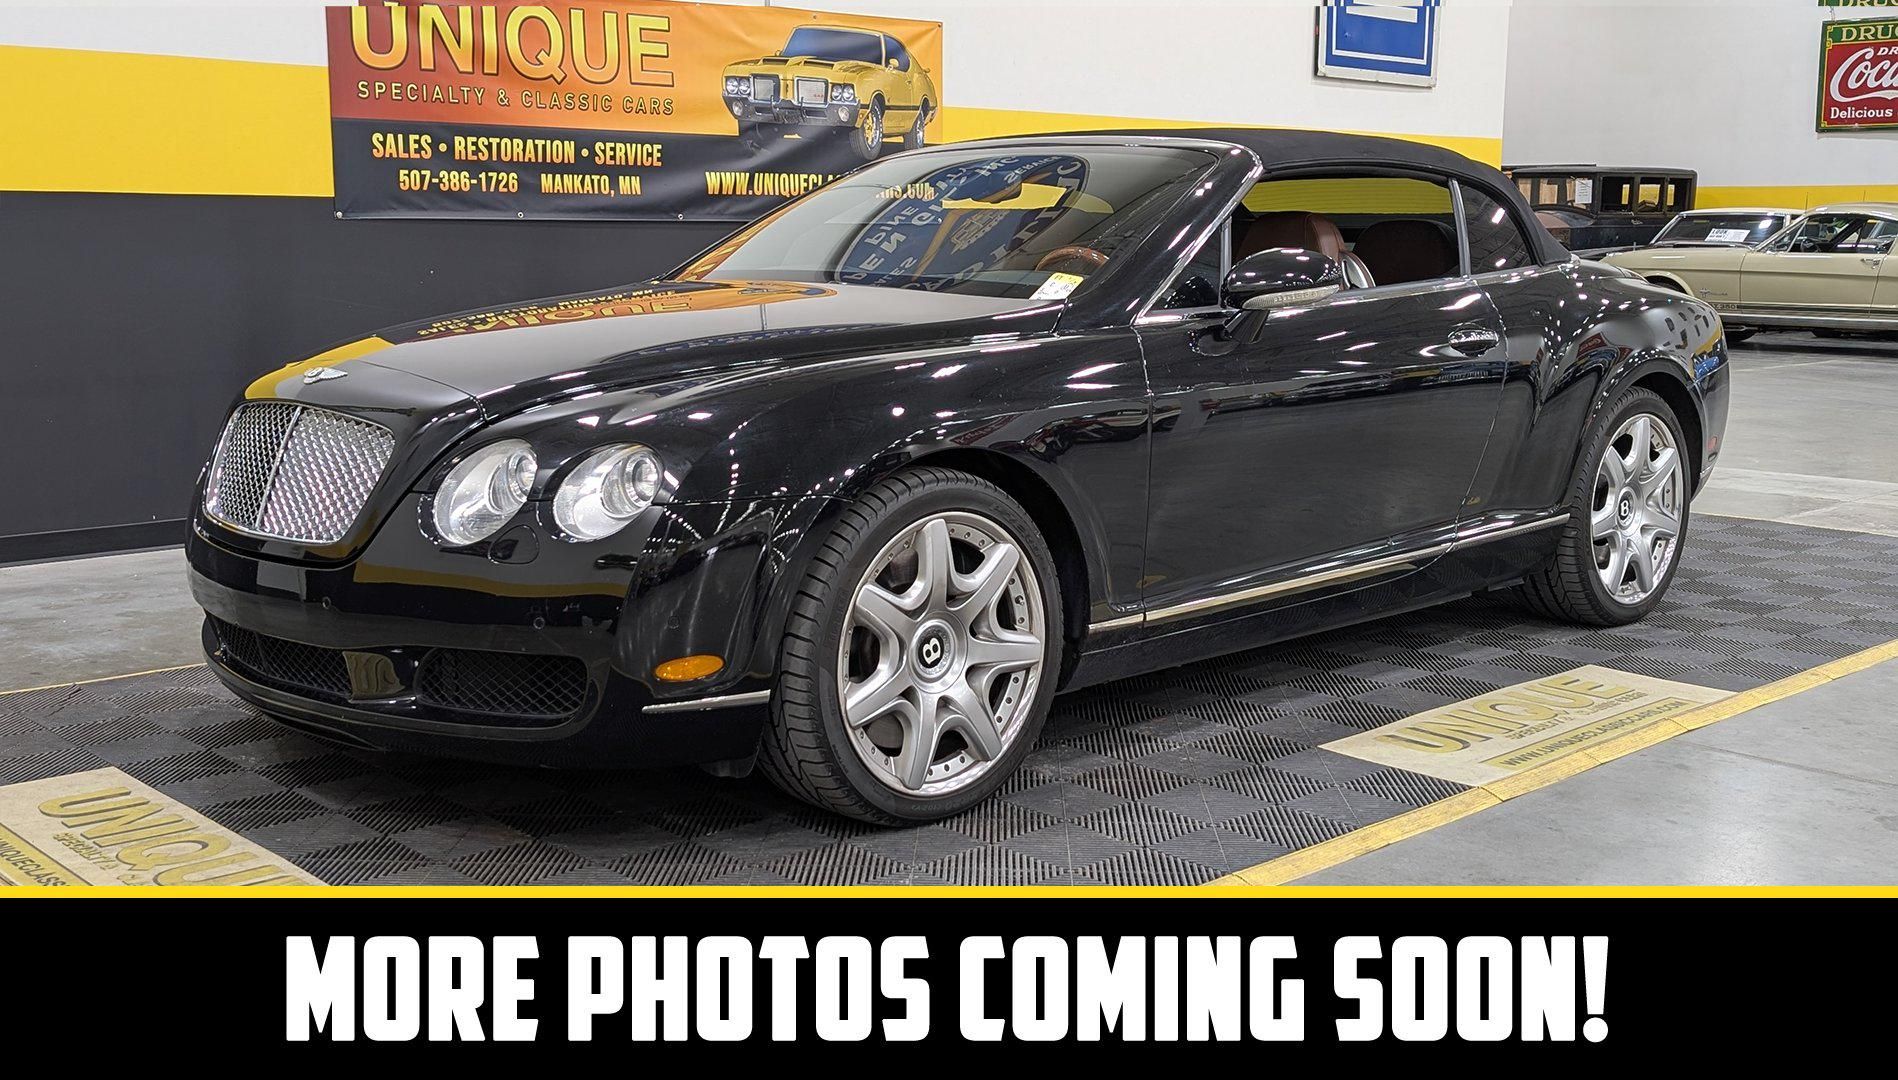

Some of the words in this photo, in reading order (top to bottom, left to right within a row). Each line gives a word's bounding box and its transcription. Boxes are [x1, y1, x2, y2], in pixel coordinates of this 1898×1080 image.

[351, 1, 675, 87] UNIQUE
[357, 80, 485, 105] SPECIALTY
[498, 89, 511, 106] &
[521, 90, 612, 112] CLASSIC
[622, 96, 674, 115] CARS
[1831, 107, 1893, 119] Delicious
[372, 132, 432, 159] SALES
[454, 135, 575, 163] RESTORATION
[595, 141, 662, 166] SERVICE
[399, 169, 518, 192] 507-386-1726
[541, 173, 614, 197] MANKATO,
[619, 176, 641, 195] MN
[1620, 500, 1631, 517] B
[922, 637, 941, 665] B
[1374, 676, 1636, 753] UNIQUE
[38, 786, 306, 886] UNIQU
